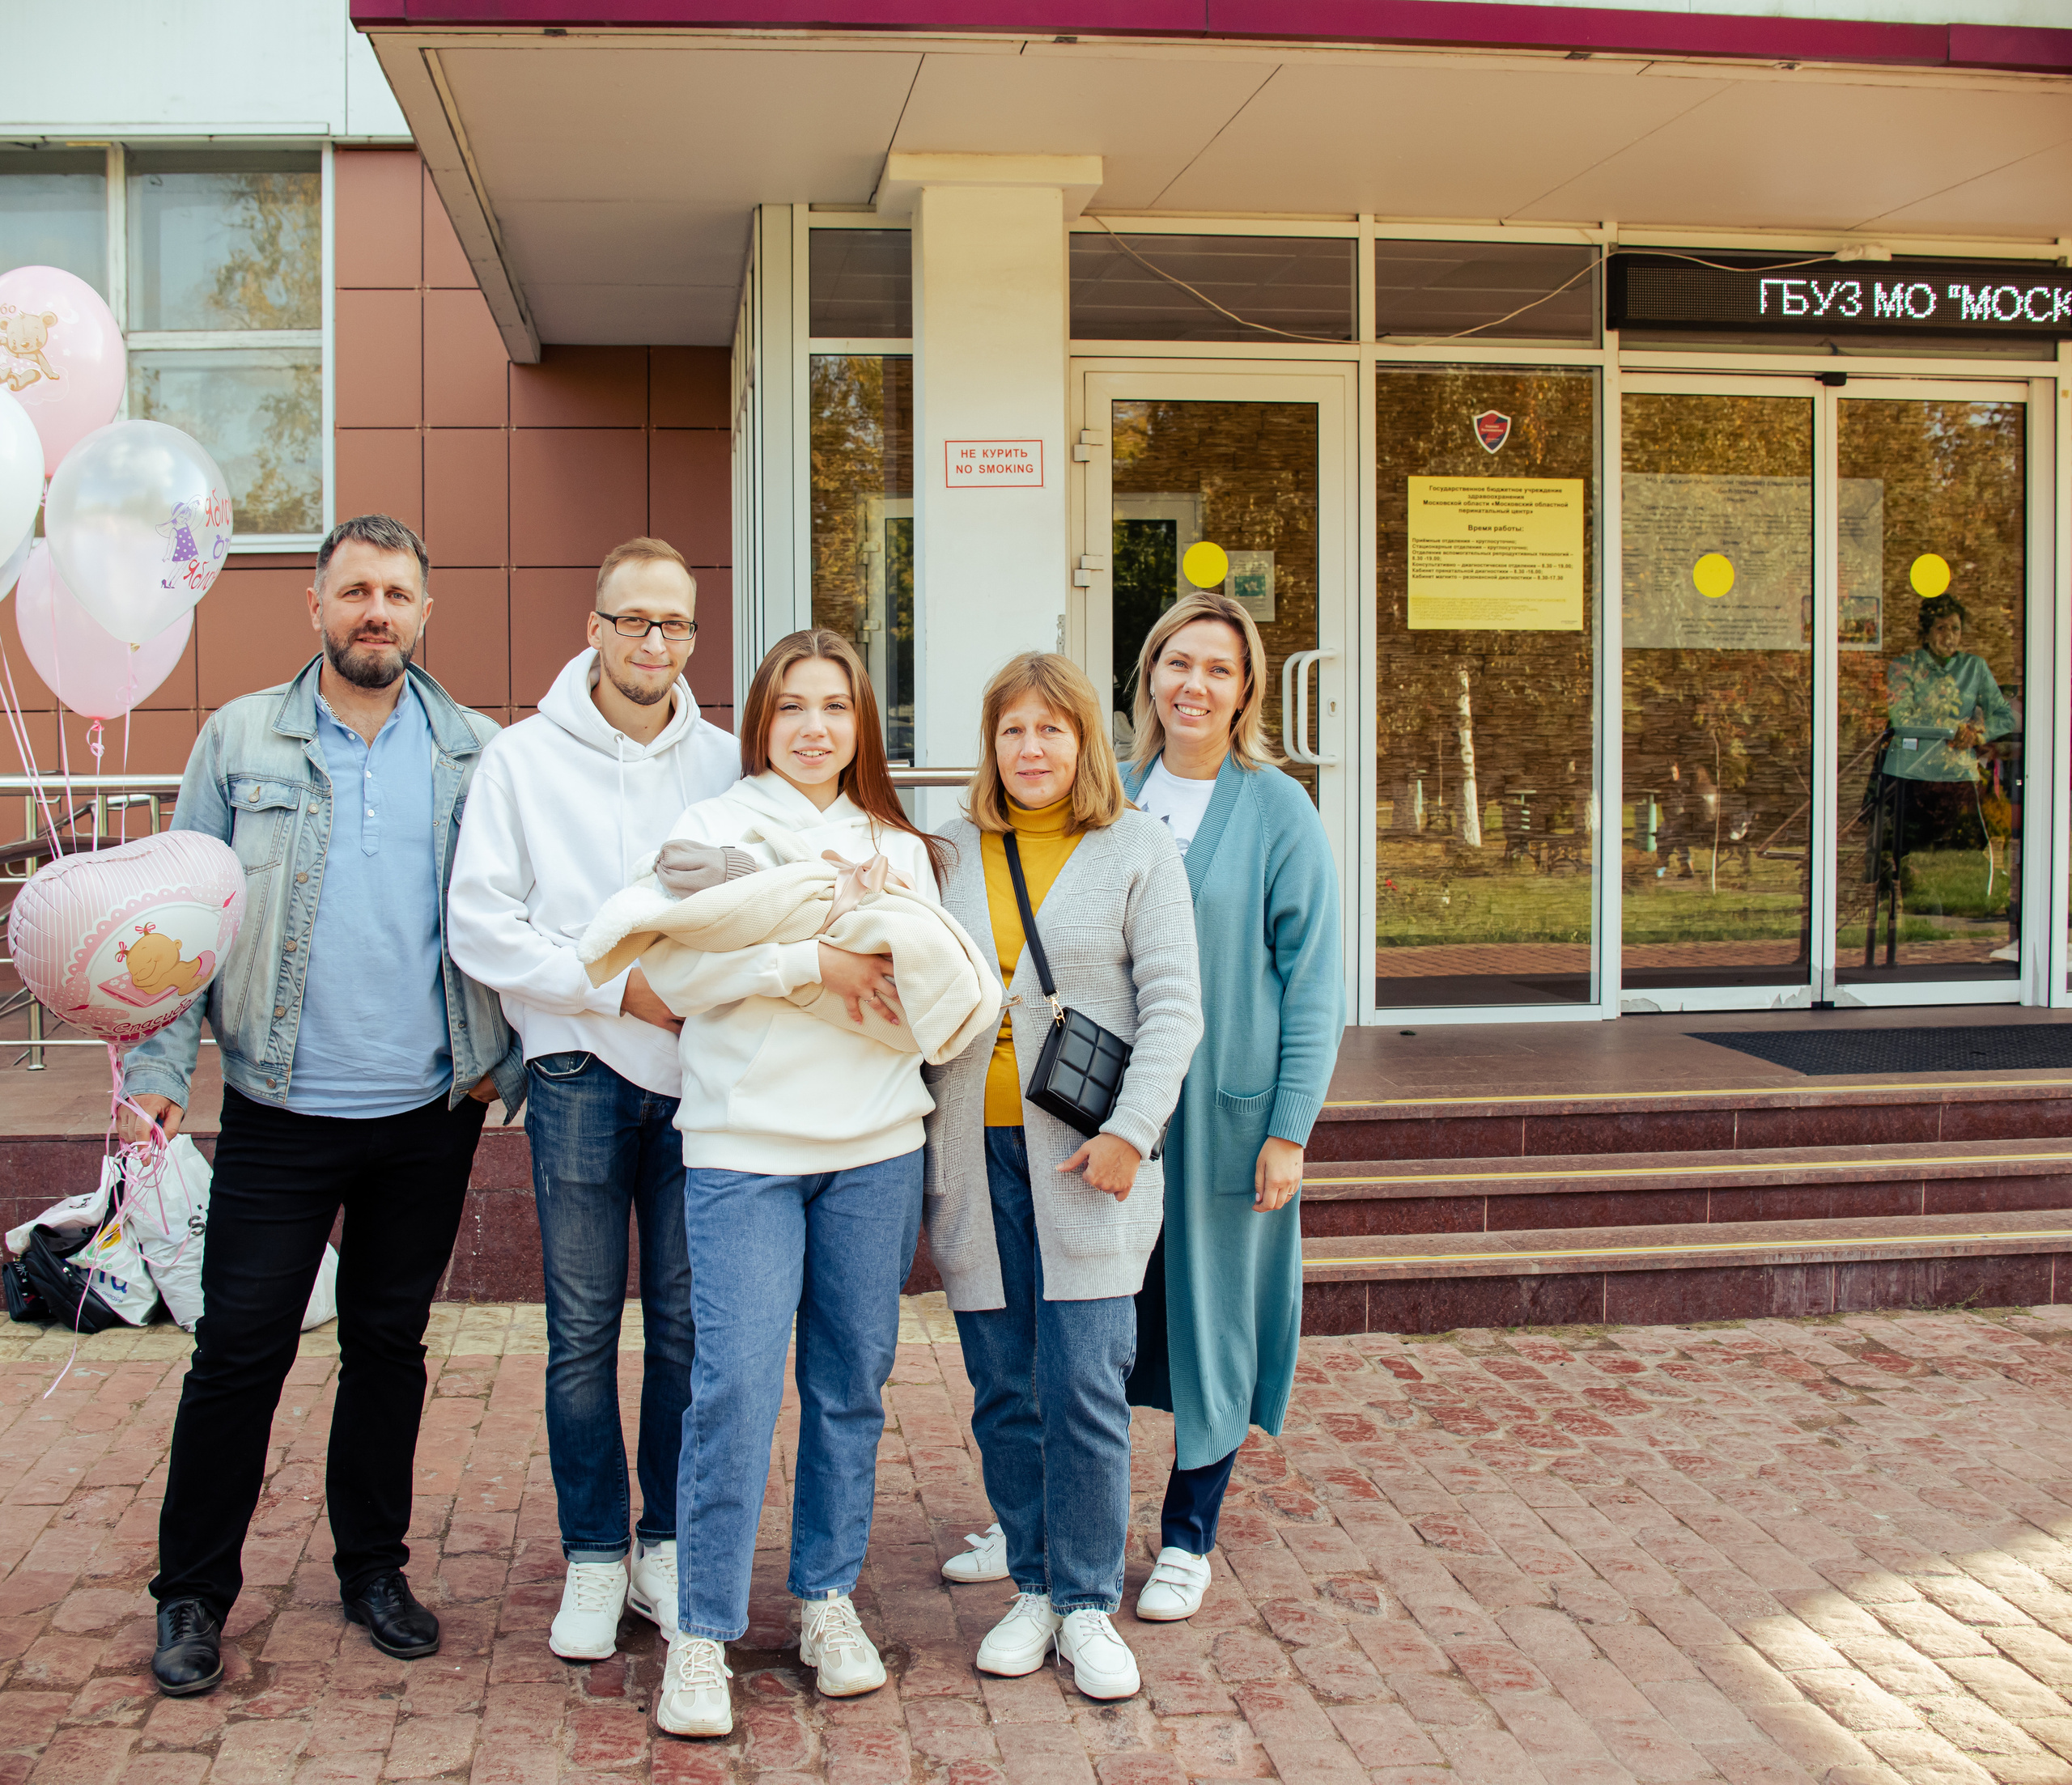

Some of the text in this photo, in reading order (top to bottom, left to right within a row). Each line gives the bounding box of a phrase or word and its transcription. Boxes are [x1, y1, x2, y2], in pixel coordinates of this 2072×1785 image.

[1759, 278, 1862, 316] ГБУЗ
[1874, 282, 1936, 319] МО
[961, 448, 1028, 458] НЕ КУРИТЬ
[956, 464, 1034, 473] NO SMOKING
[113, 998, 192, 1033] Спасибо
